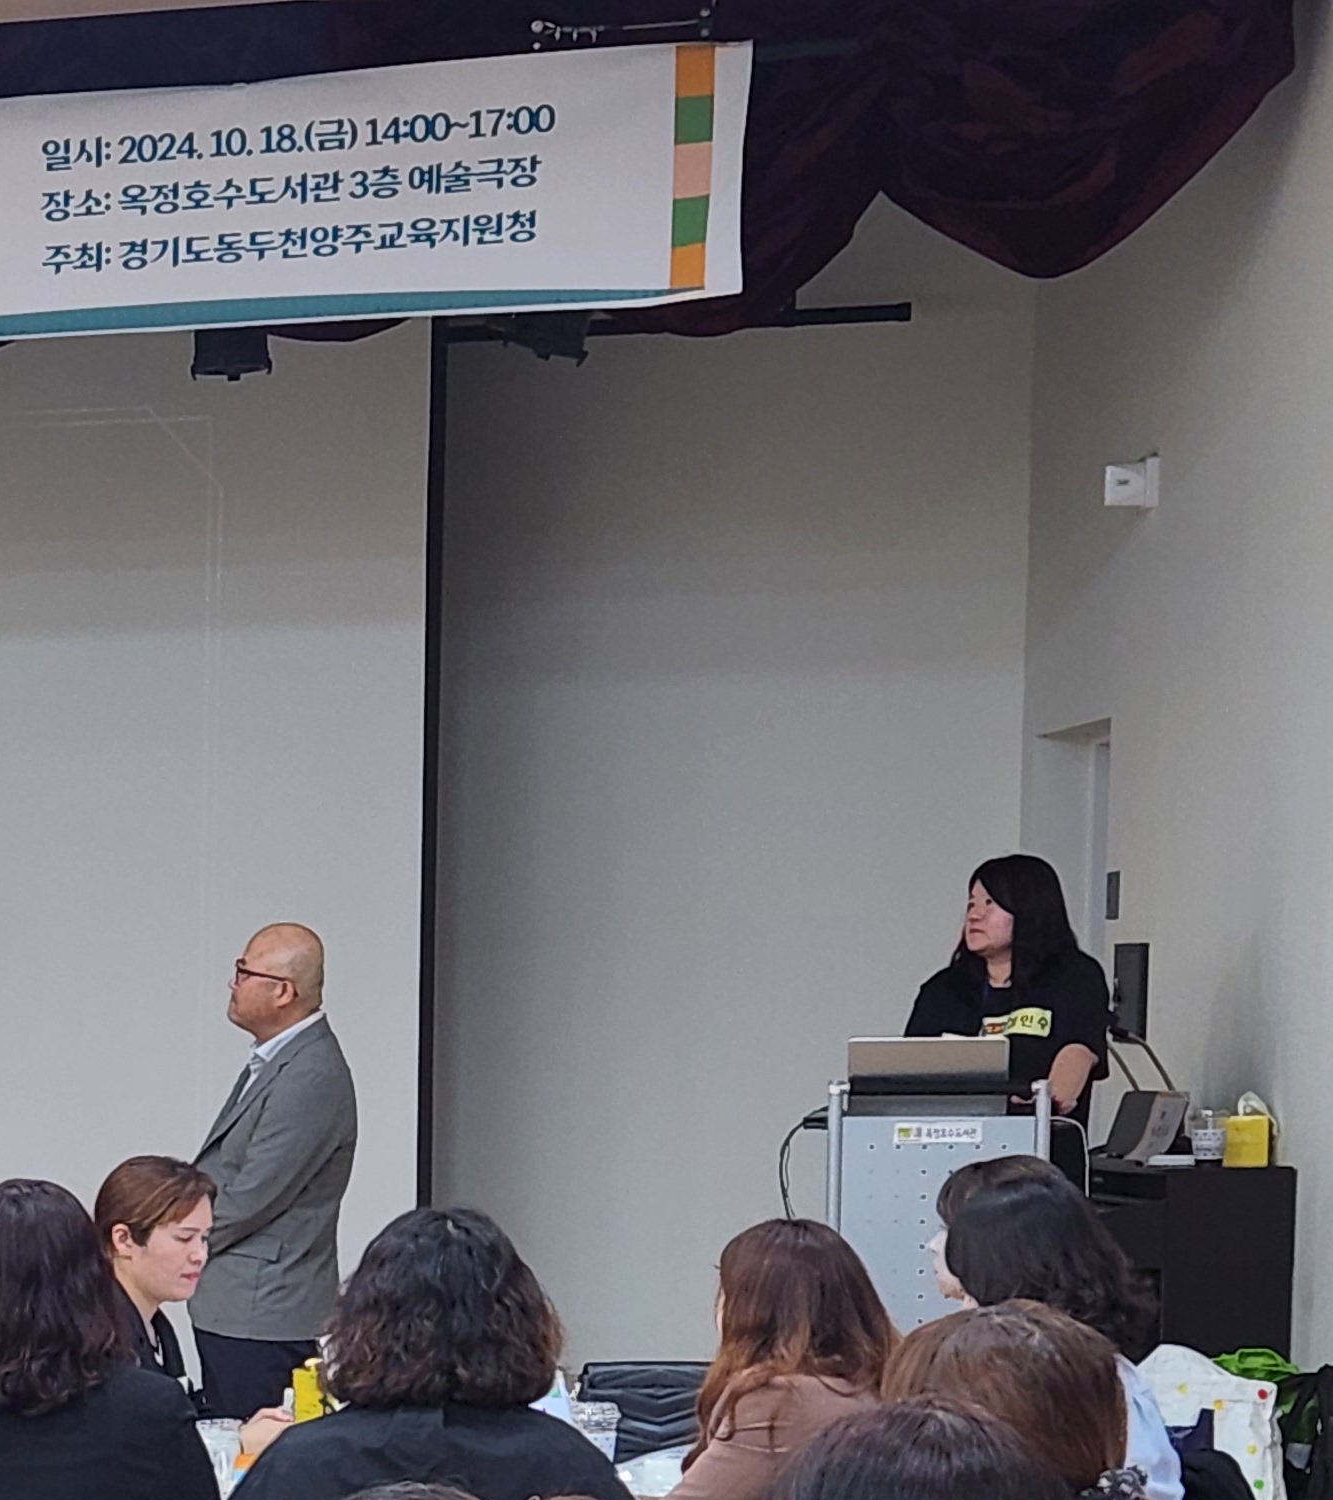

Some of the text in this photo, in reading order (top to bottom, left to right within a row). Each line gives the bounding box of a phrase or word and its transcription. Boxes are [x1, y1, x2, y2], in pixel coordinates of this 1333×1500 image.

[40, 133, 112, 172] 일시:
[364, 103, 556, 147] 14:00~17:00
[40, 154, 543, 222] 장소: 옥정호수도서관 3층 예술극장
[40, 209, 538, 276] 주최: 경기도동두천양주교육지원청
